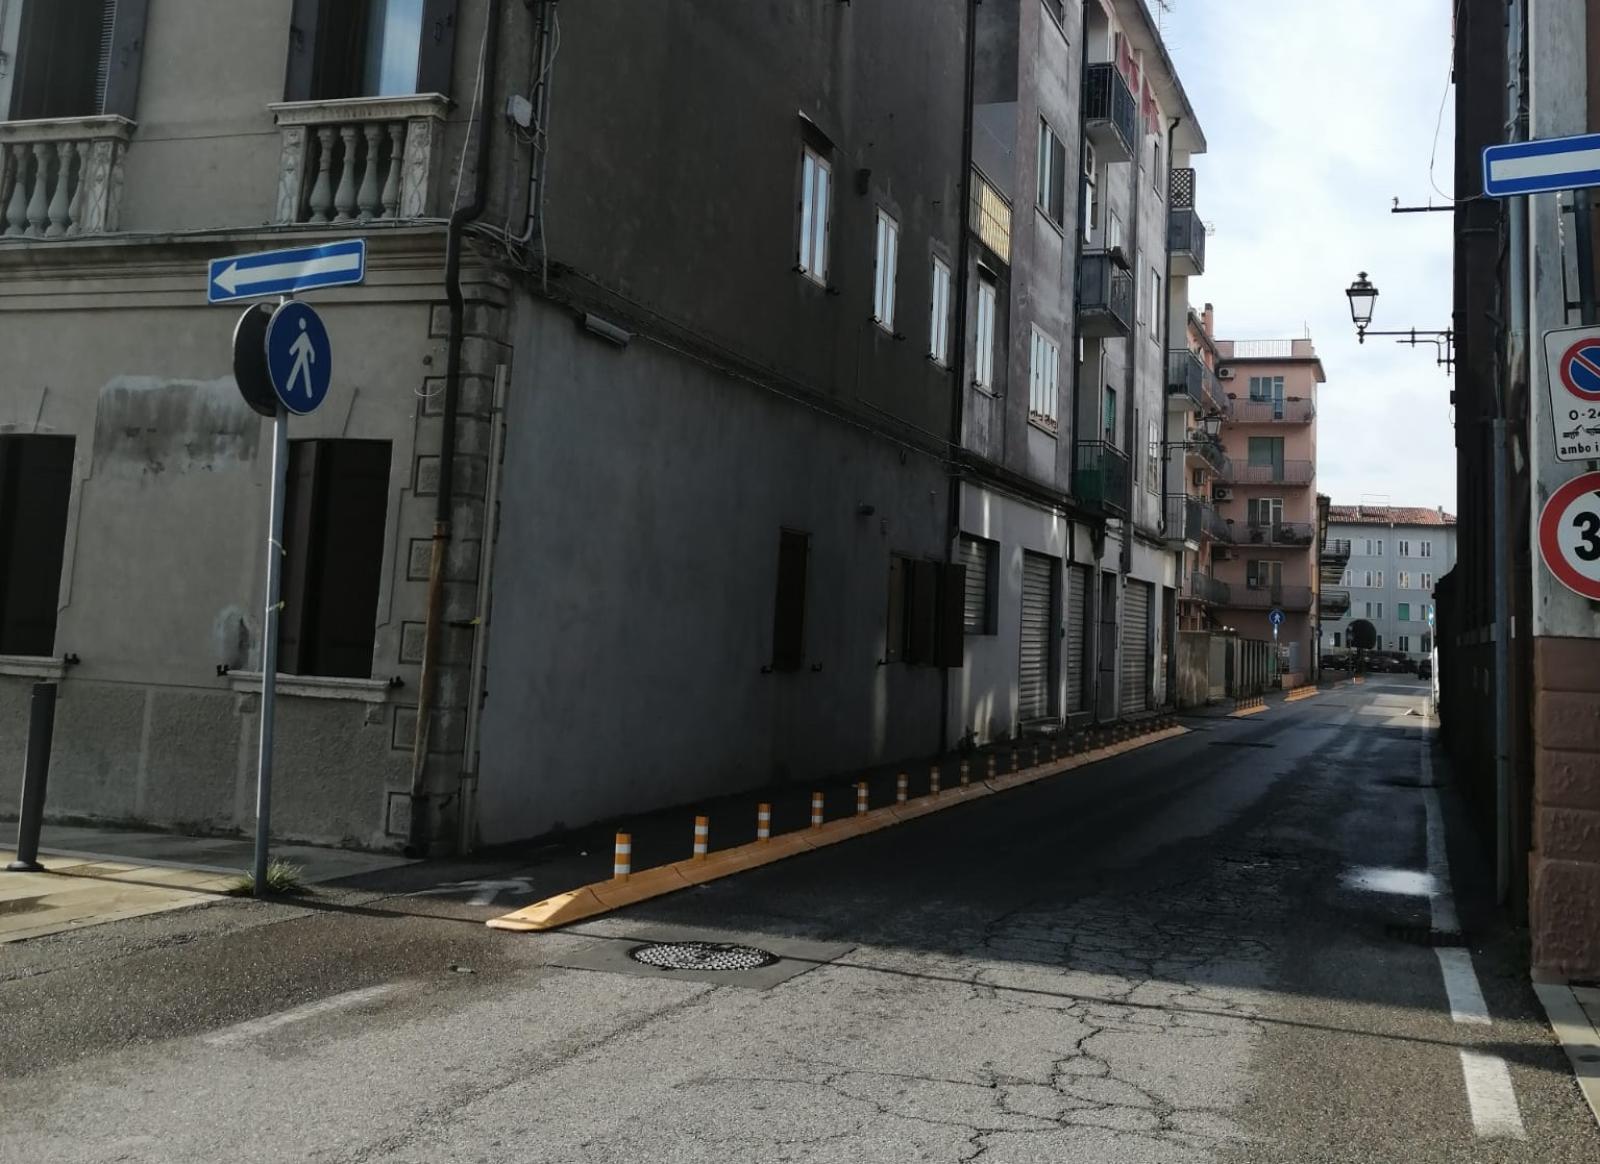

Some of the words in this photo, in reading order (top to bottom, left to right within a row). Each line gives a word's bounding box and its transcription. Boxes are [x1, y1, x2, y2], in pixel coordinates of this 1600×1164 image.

[1569, 408, 1600, 420] 0-2
[1561, 442, 1591, 455] ambo
[1594, 441, 1599, 452] i
[1573, 511, 1600, 561] 3
